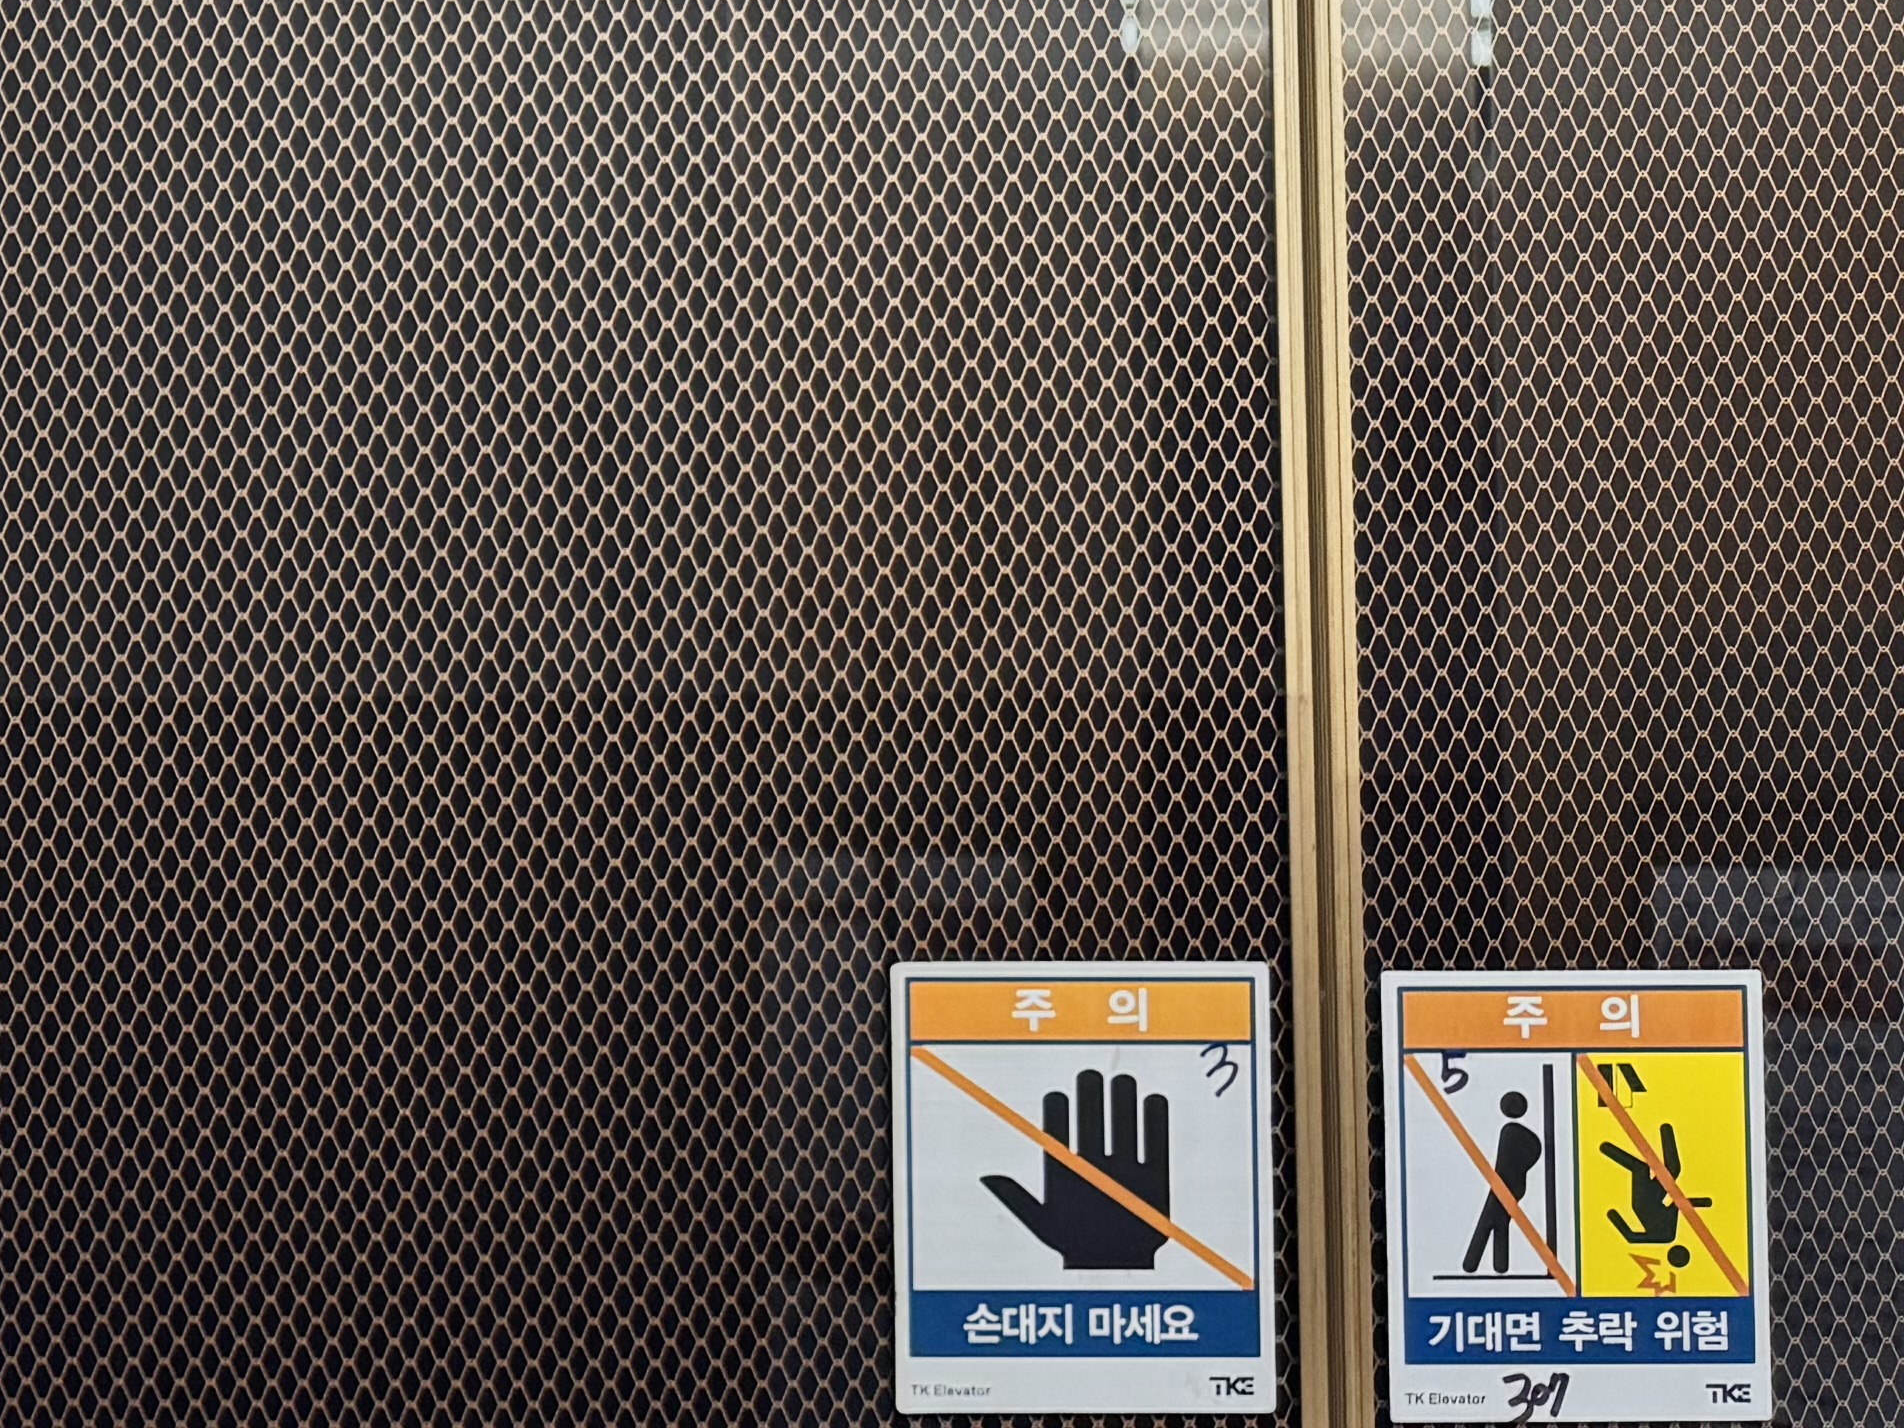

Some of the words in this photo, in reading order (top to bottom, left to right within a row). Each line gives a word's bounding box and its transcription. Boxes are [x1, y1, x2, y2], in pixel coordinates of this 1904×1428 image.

[1198, 1041, 1241, 1098] 3
[1436, 1048, 1471, 1095] 5
[961, 1301, 1075, 1348] 손대지
[1086, 1301, 1201, 1348] 마세요
[1427, 1310, 1543, 1355] 기대면
[1557, 1310, 1639, 1355] 추락
[1653, 1309, 1730, 1354] 위험
[910, 1383, 932, 1398] TK
[933, 1382, 992, 1398] Elevator
[1209, 1376, 1256, 1396] TKE
[1402, 1391, 1426, 1406] TK
[1427, 1390, 1487, 1406] Elevator
[1705, 1382, 1752, 1404] TKE
